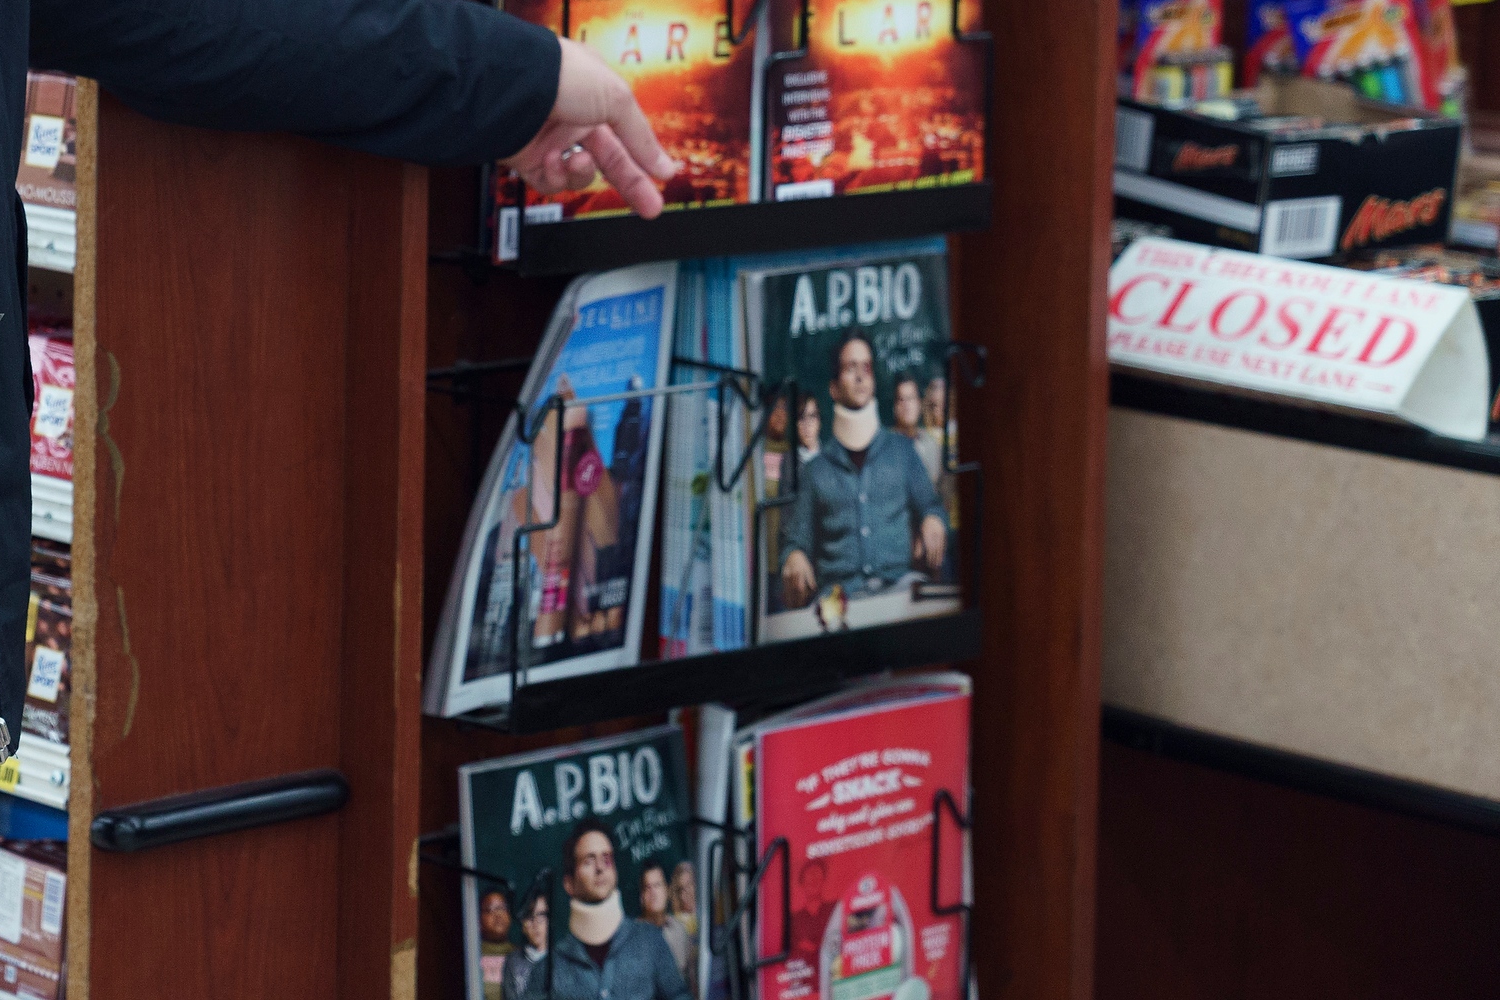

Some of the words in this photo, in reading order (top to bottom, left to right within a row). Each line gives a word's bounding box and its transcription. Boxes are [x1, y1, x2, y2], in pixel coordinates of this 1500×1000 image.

[1341, 187, 1446, 251] Mars
[1109, 272, 1418, 370] CLOSED
[832, 767, 902, 806] SNACK
